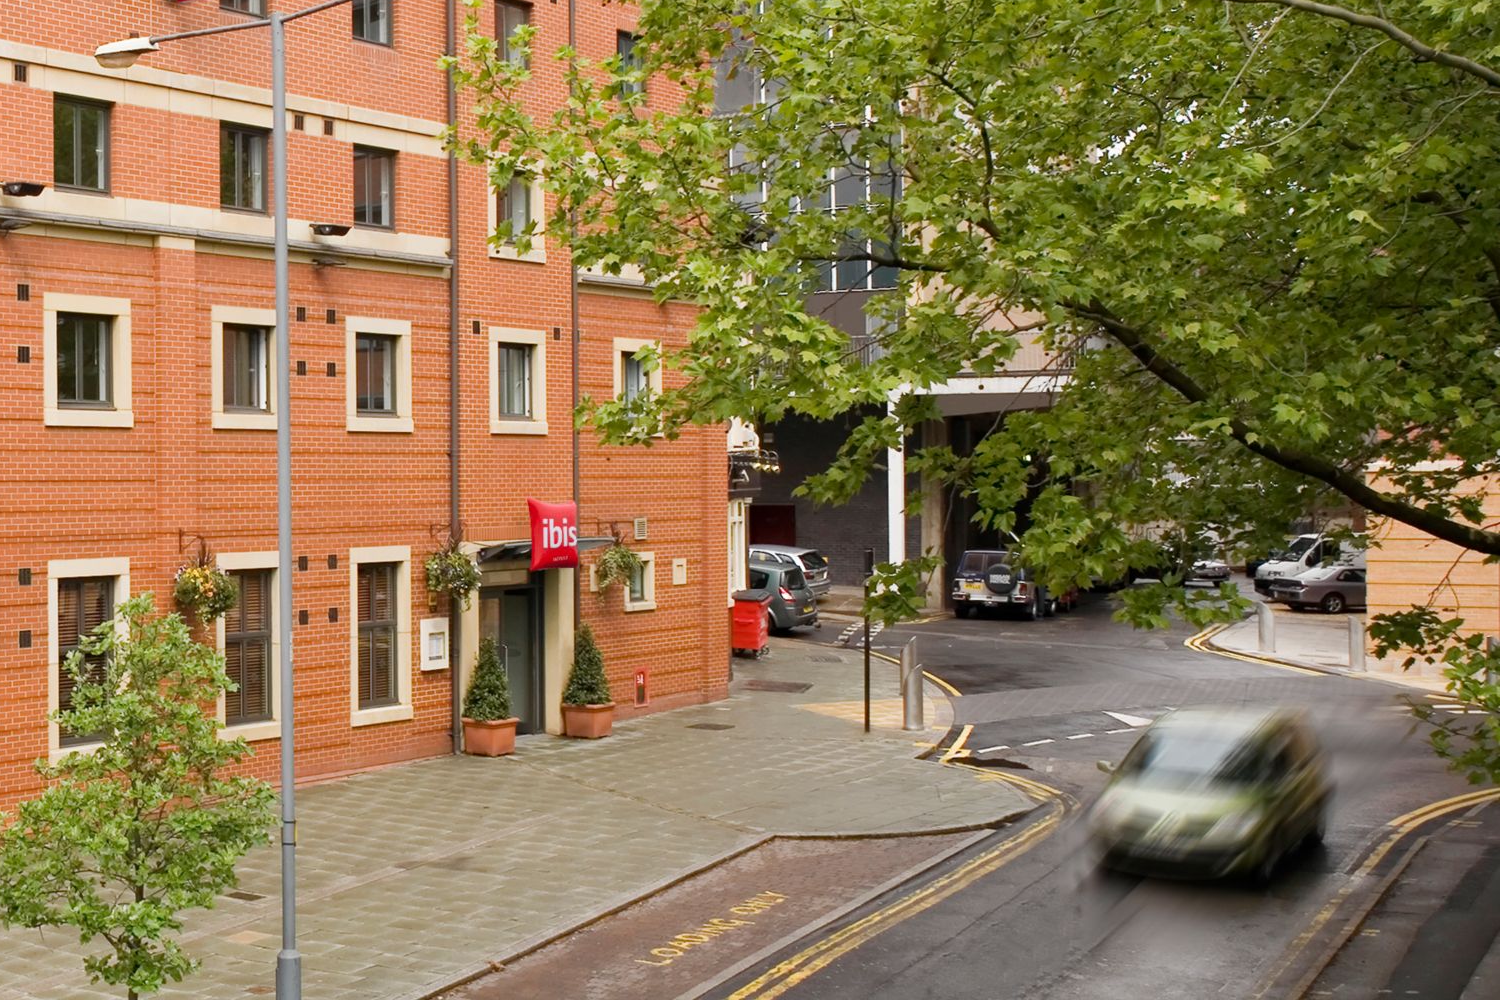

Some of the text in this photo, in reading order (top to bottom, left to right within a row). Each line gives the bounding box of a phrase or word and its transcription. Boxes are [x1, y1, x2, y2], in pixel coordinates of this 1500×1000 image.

[542, 517, 578, 549] ibis
[634, 890, 790, 966] LOADING ONLY
